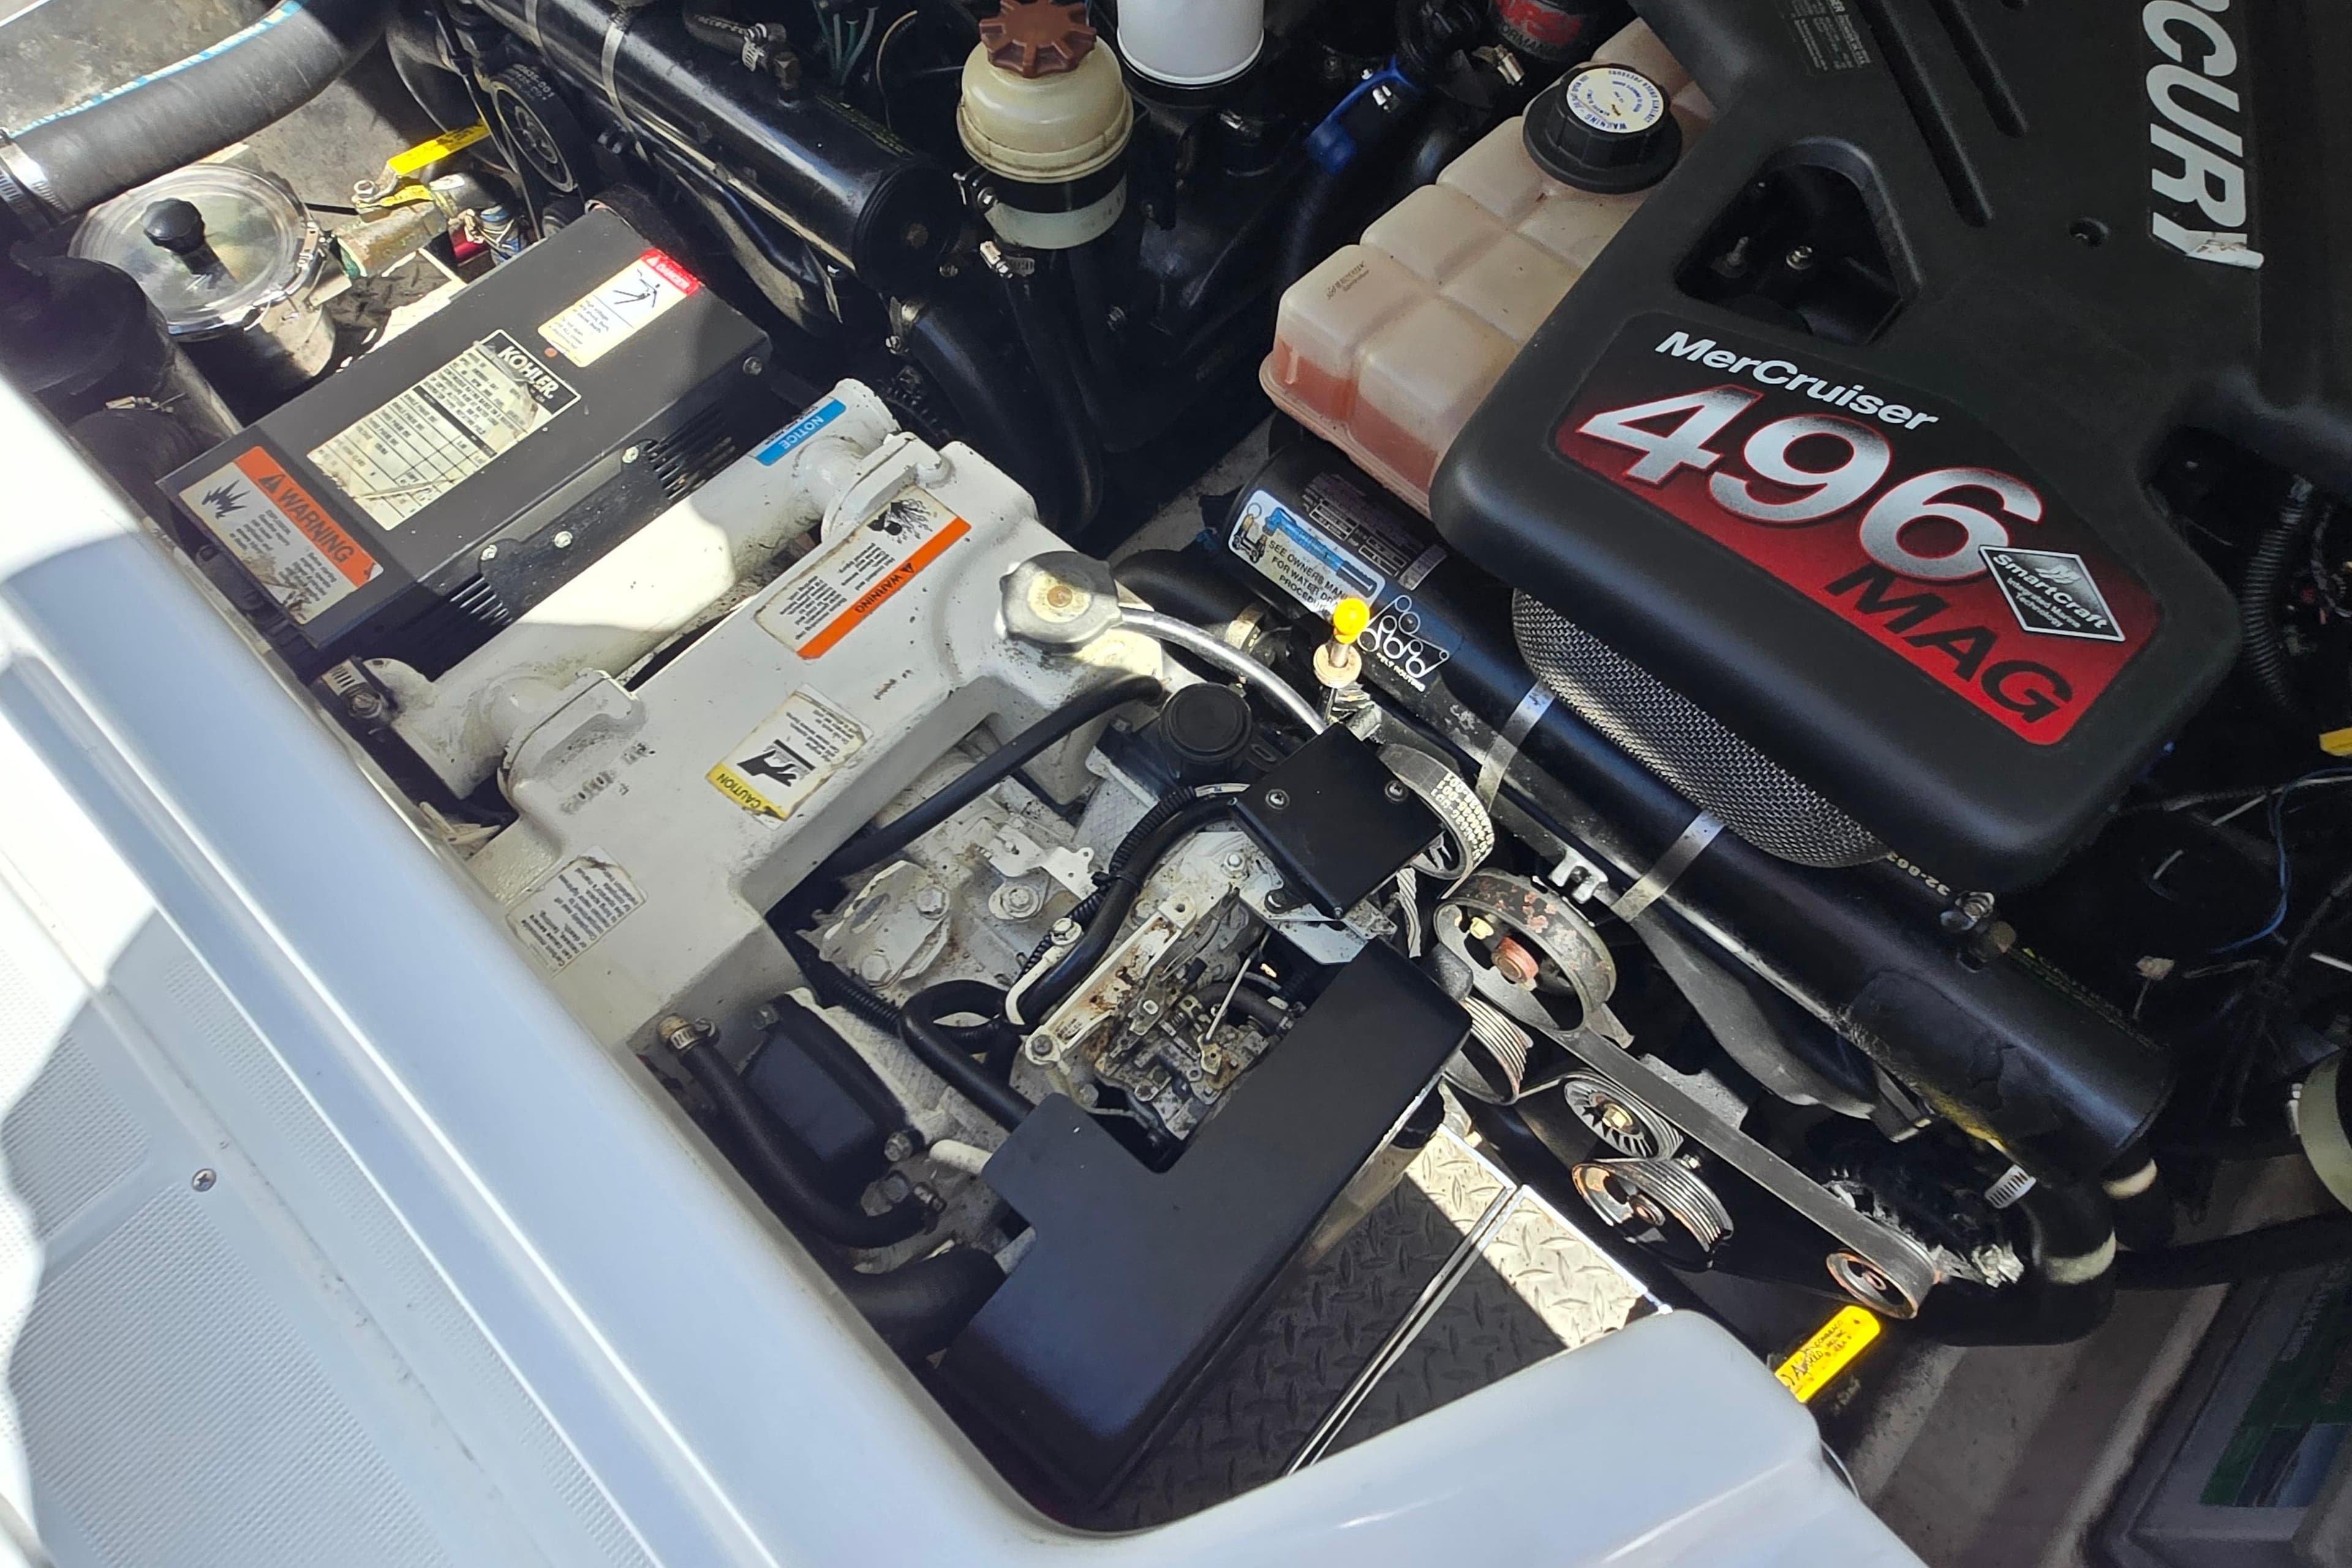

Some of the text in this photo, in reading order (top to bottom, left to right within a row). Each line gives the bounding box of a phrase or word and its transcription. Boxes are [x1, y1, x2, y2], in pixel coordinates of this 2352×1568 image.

[1585, 114, 1627, 130] WARNING
[2142, 0, 2264, 270] CURY
[655, 262, 690, 290] DANGER
[1656, 330, 1938, 431] MerCruiser
[778, 415, 823, 448] NOTICE
[1577, 383, 2043, 582] 496
[276, 489, 354, 564] WARNING
[307, 552, 337, 582] Before starting
[1267, 540, 1287, 557] SEE
[1286, 553, 1325, 584] OWNERS
[1270, 556, 1290, 573] FOR
[1289, 570, 1321, 595] WATER
[853, 572, 903, 614] WARNING
[1991, 552, 2109, 629] SmartCraft
[2005, 576, 2082, 629] Integrated Marine
[2014, 592, 2064, 628] Technology
[1827, 567, 2073, 723] MAG
[1392, 665, 1425, 692] ROUTING
[717, 773, 761, 809] CAUTION
[557, 873, 610, 930] maintain vapor tightness
[575, 866, 624, 918] See operator's manual
[601, 881, 625, 905] complete
[611, 880, 638, 907] installation
[529, 913, 548, 933] severe
[569, 913, 597, 941] Completely
[572, 902, 603, 935] compartment
[597, 903, 612, 918] living
[519, 918, 547, 946] monoxide
[545, 932, 562, 949] cause
[557, 932, 579, 956] nausea,
[562, 922, 581, 942] death.
[543, 944, 565, 967] Carbon
[560, 948, 572, 960] can
